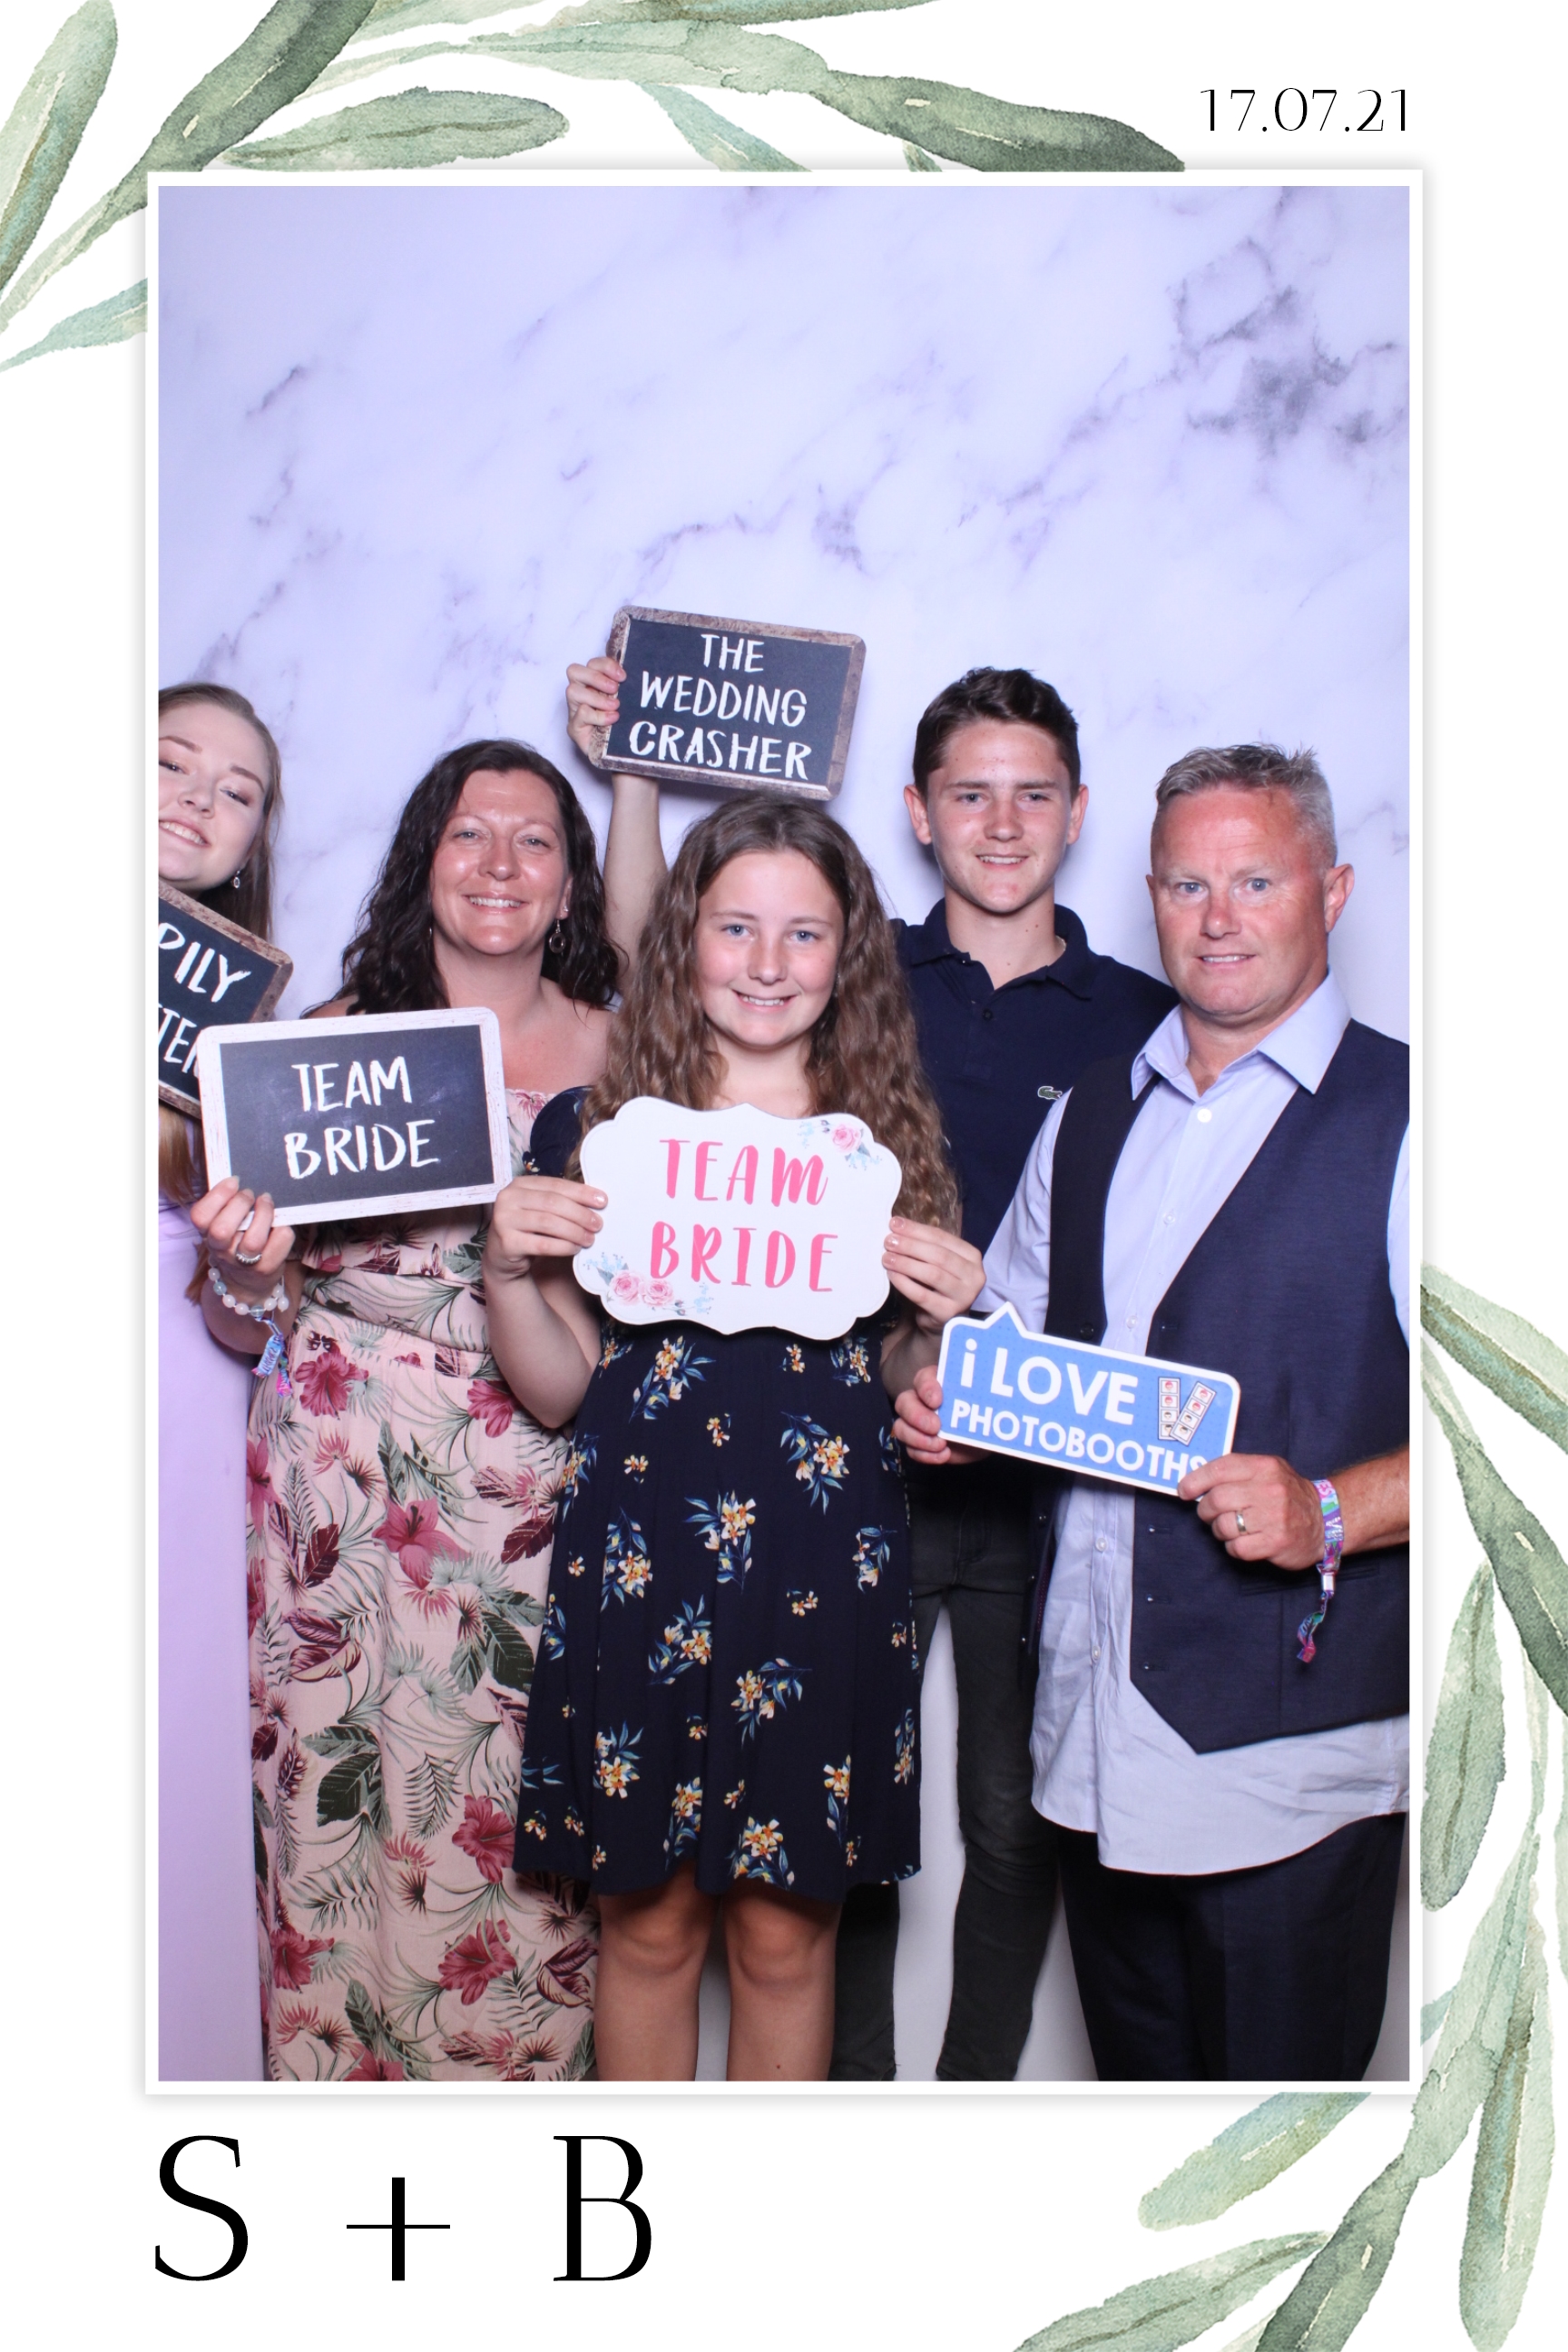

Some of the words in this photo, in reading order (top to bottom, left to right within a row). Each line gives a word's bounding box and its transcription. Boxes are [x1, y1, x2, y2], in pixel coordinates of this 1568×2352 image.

[701, 633, 765, 673] THE
[640, 671, 808, 727] WEDDING
[629, 720, 812, 780] CRASHER
[290, 1055, 412, 1112] TEAM
[284, 1119, 439, 1180] BRIDE
[659, 1138, 828, 1207] TEAM
[650, 1220, 838, 1292] BRIDE
[990, 1347, 1138, 1426] LOVE
